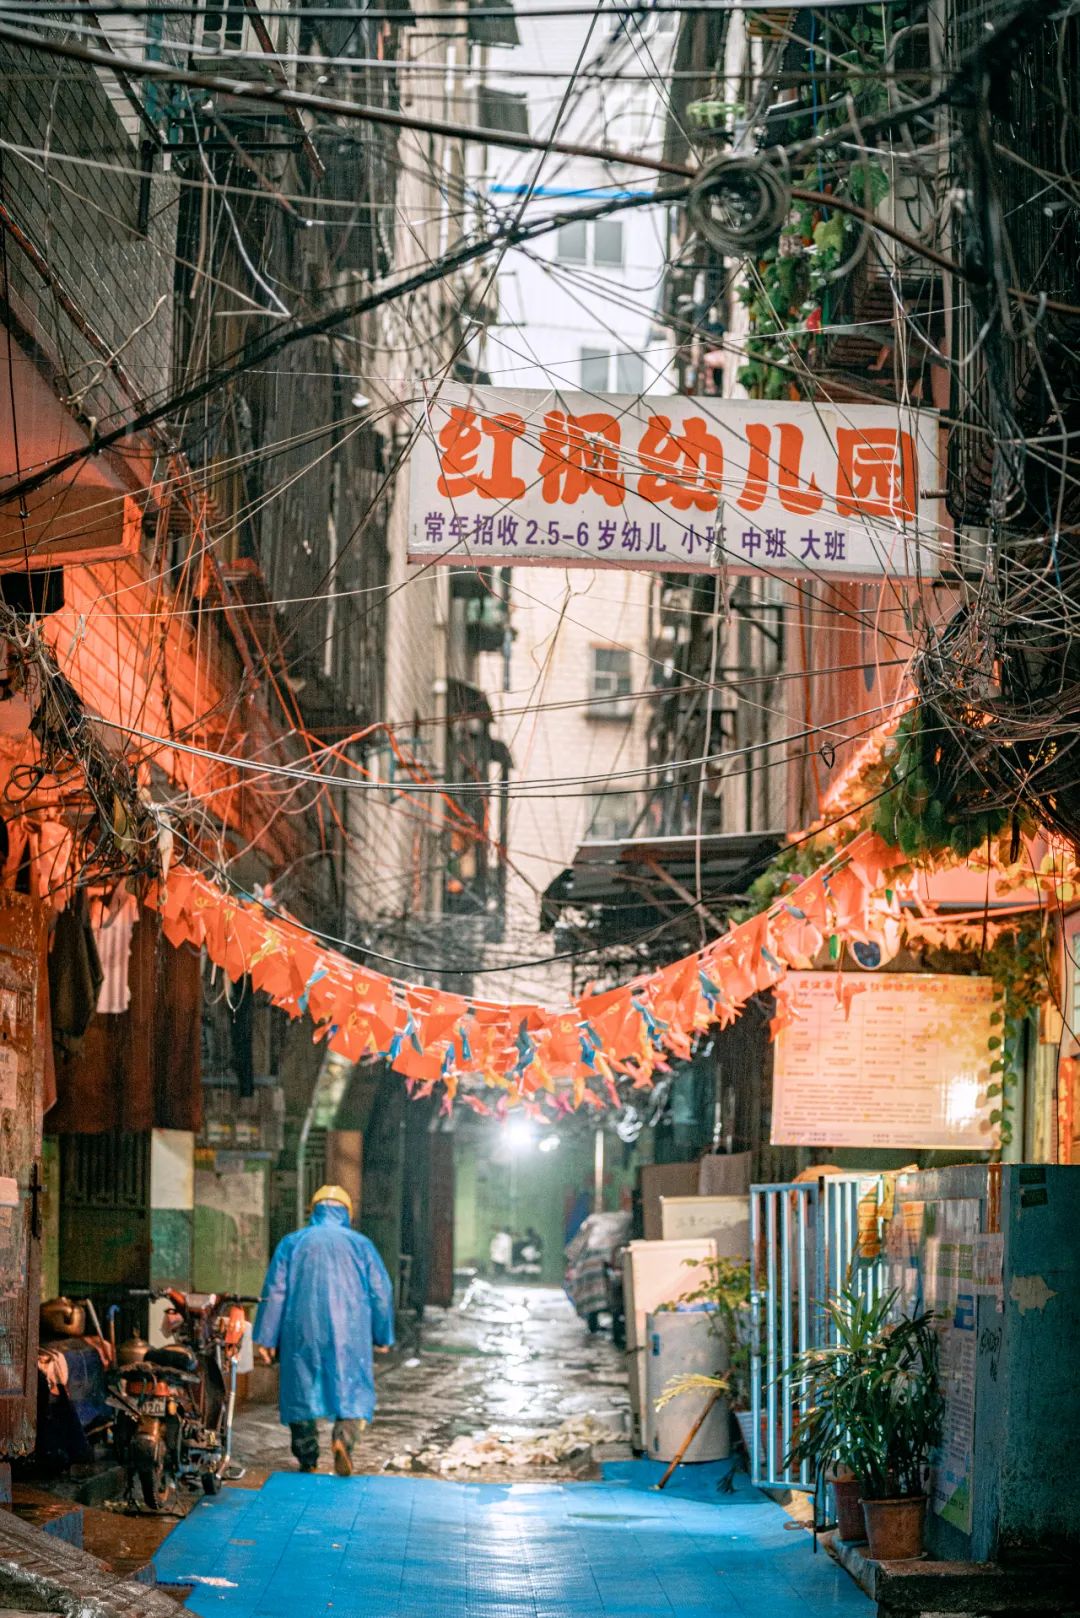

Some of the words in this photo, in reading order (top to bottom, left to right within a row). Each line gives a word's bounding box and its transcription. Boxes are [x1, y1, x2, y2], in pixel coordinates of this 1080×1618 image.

[437, 406, 918, 523] 红枫幼儿园
[741, 526, 787, 559] 中班
[800, 529, 846, 562] 大班
